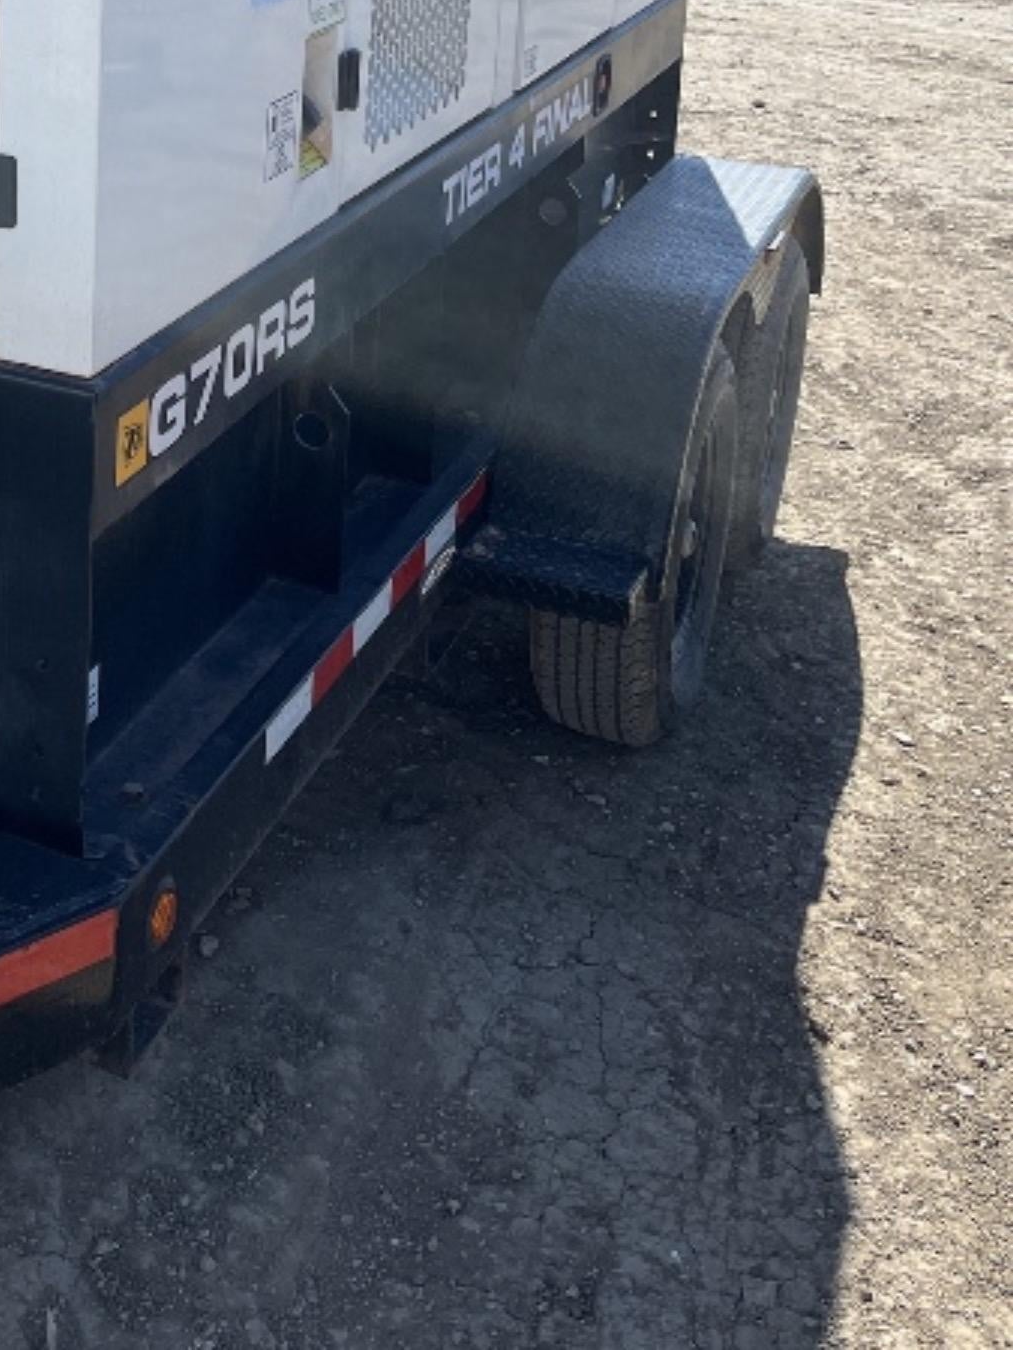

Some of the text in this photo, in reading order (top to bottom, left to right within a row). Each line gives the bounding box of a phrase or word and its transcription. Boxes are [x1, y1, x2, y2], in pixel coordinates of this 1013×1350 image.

[442, 77, 592, 227] TIER 4 FINAL
[149, 278, 317, 459] G70RS
